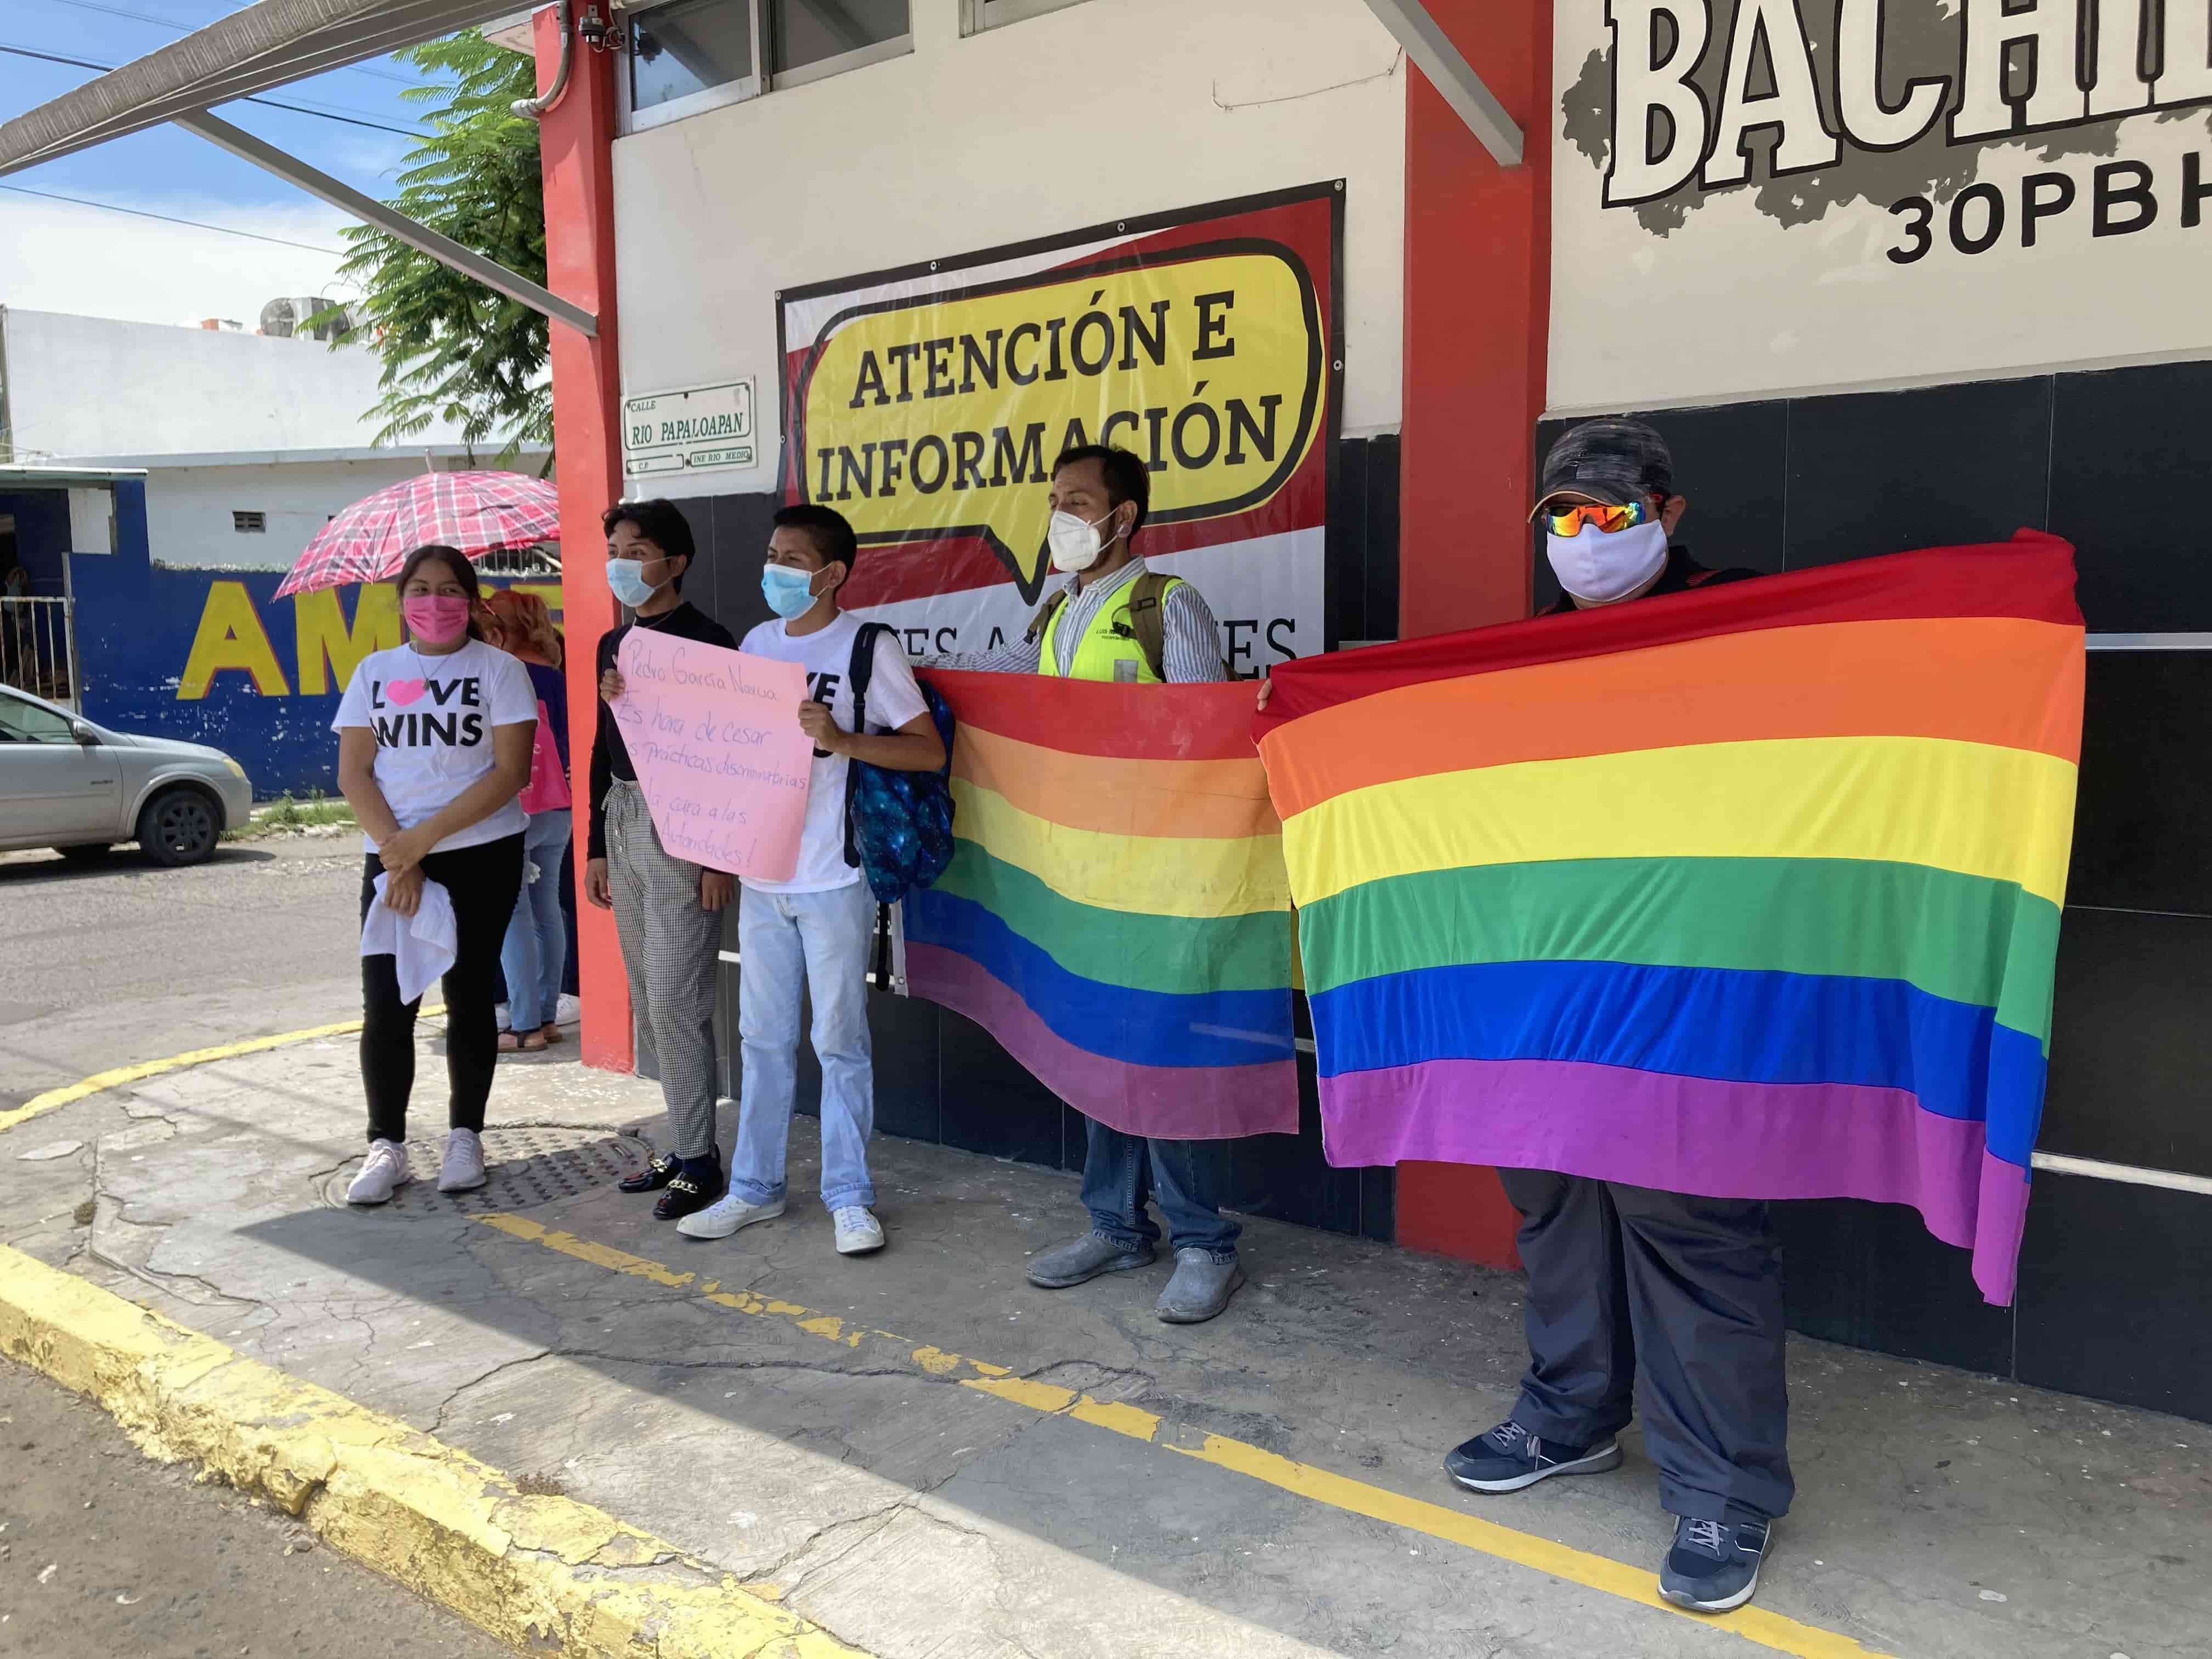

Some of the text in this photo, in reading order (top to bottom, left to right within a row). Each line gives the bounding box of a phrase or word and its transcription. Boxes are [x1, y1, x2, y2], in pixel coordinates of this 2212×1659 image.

[849, 289, 1235, 409] ATENCIÓN E
[630, 400, 656, 413] CALLE
[631, 412, 743, 445] RIO PAPALOAPAN
[815, 380, 1283, 502] INFORMACIÓN
[708, 453, 720, 461] RIO
[725, 450, 749, 460] MEDIO
[628, 639, 666, 681] Pedro
[1215, 618, 1297, 679] ES
[369, 712, 483, 747] WINS
